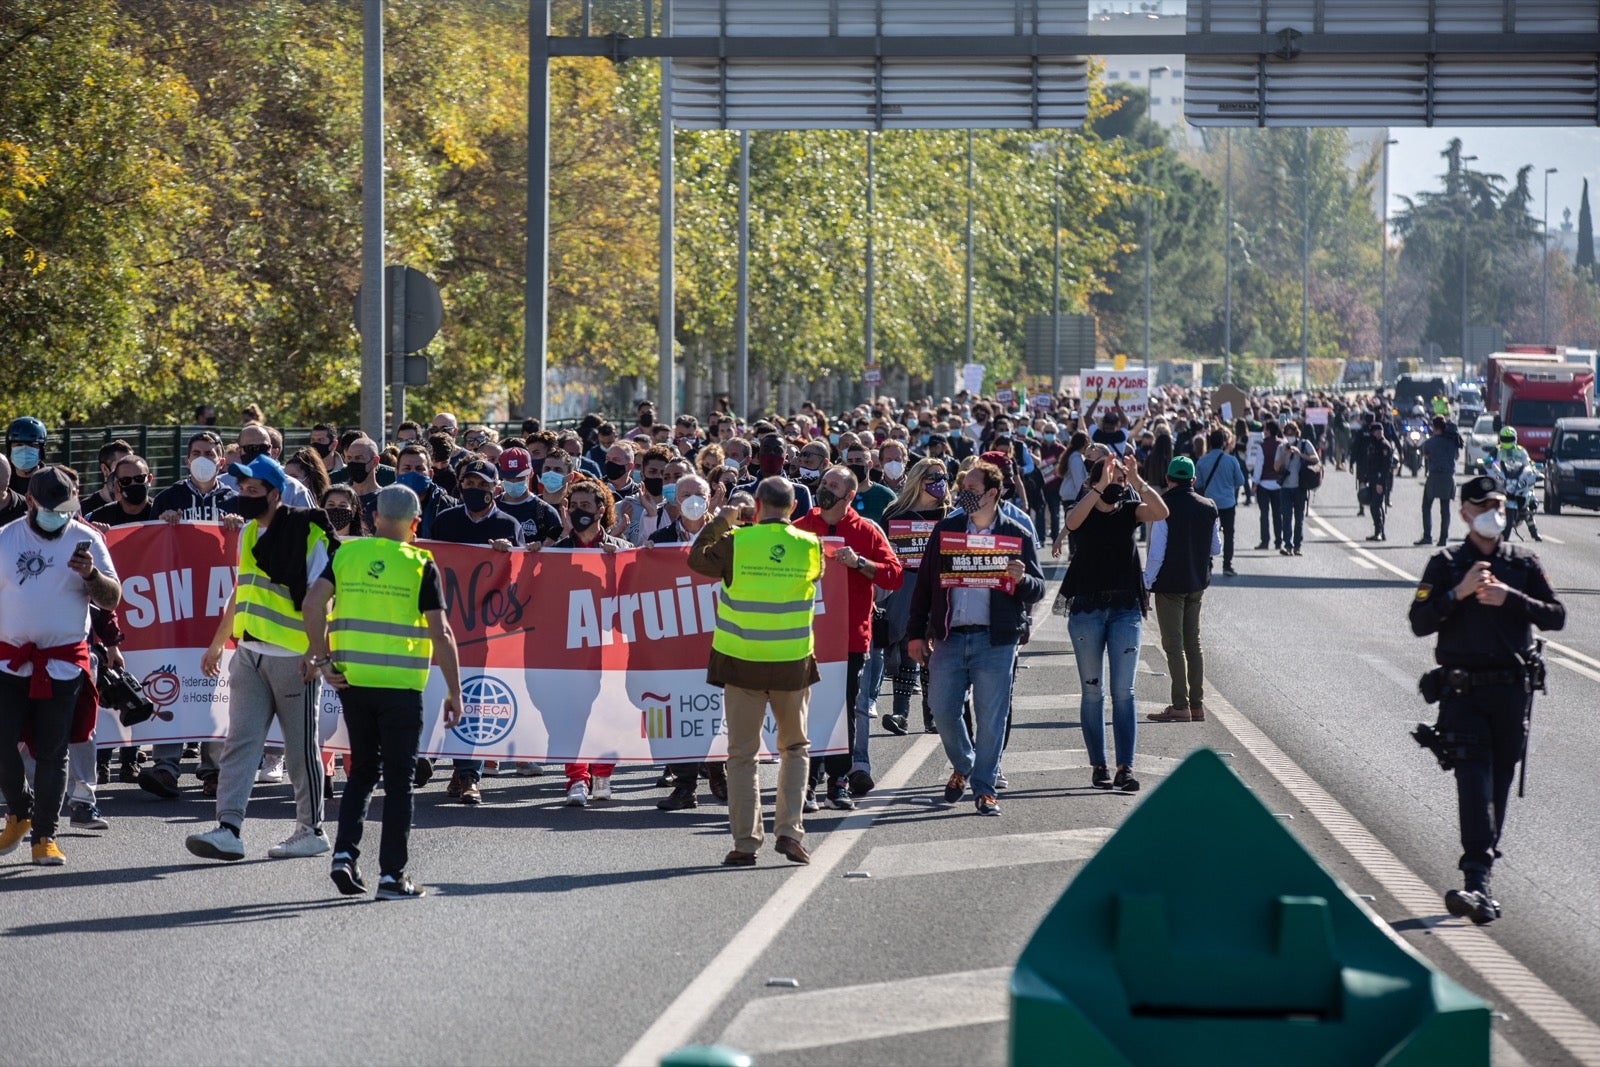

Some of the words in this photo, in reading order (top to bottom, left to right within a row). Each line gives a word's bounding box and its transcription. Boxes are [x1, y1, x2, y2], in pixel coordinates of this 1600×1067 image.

[1086, 376, 1103, 387] NO
[1107, 376, 1149, 389] AYUDAS
[972, 556, 983, 566] DE
[122, 568, 193, 628] SIN
[206, 566, 239, 616] A
[444, 561, 531, 631] Nos
[566, 576, 722, 649] Arruin
[190, 692, 229, 703] Hostele
[323, 702, 345, 714] Gra
[464, 704, 509, 716] ORECA
[680, 692, 723, 713] HOS
[681, 719, 704, 738] DE
